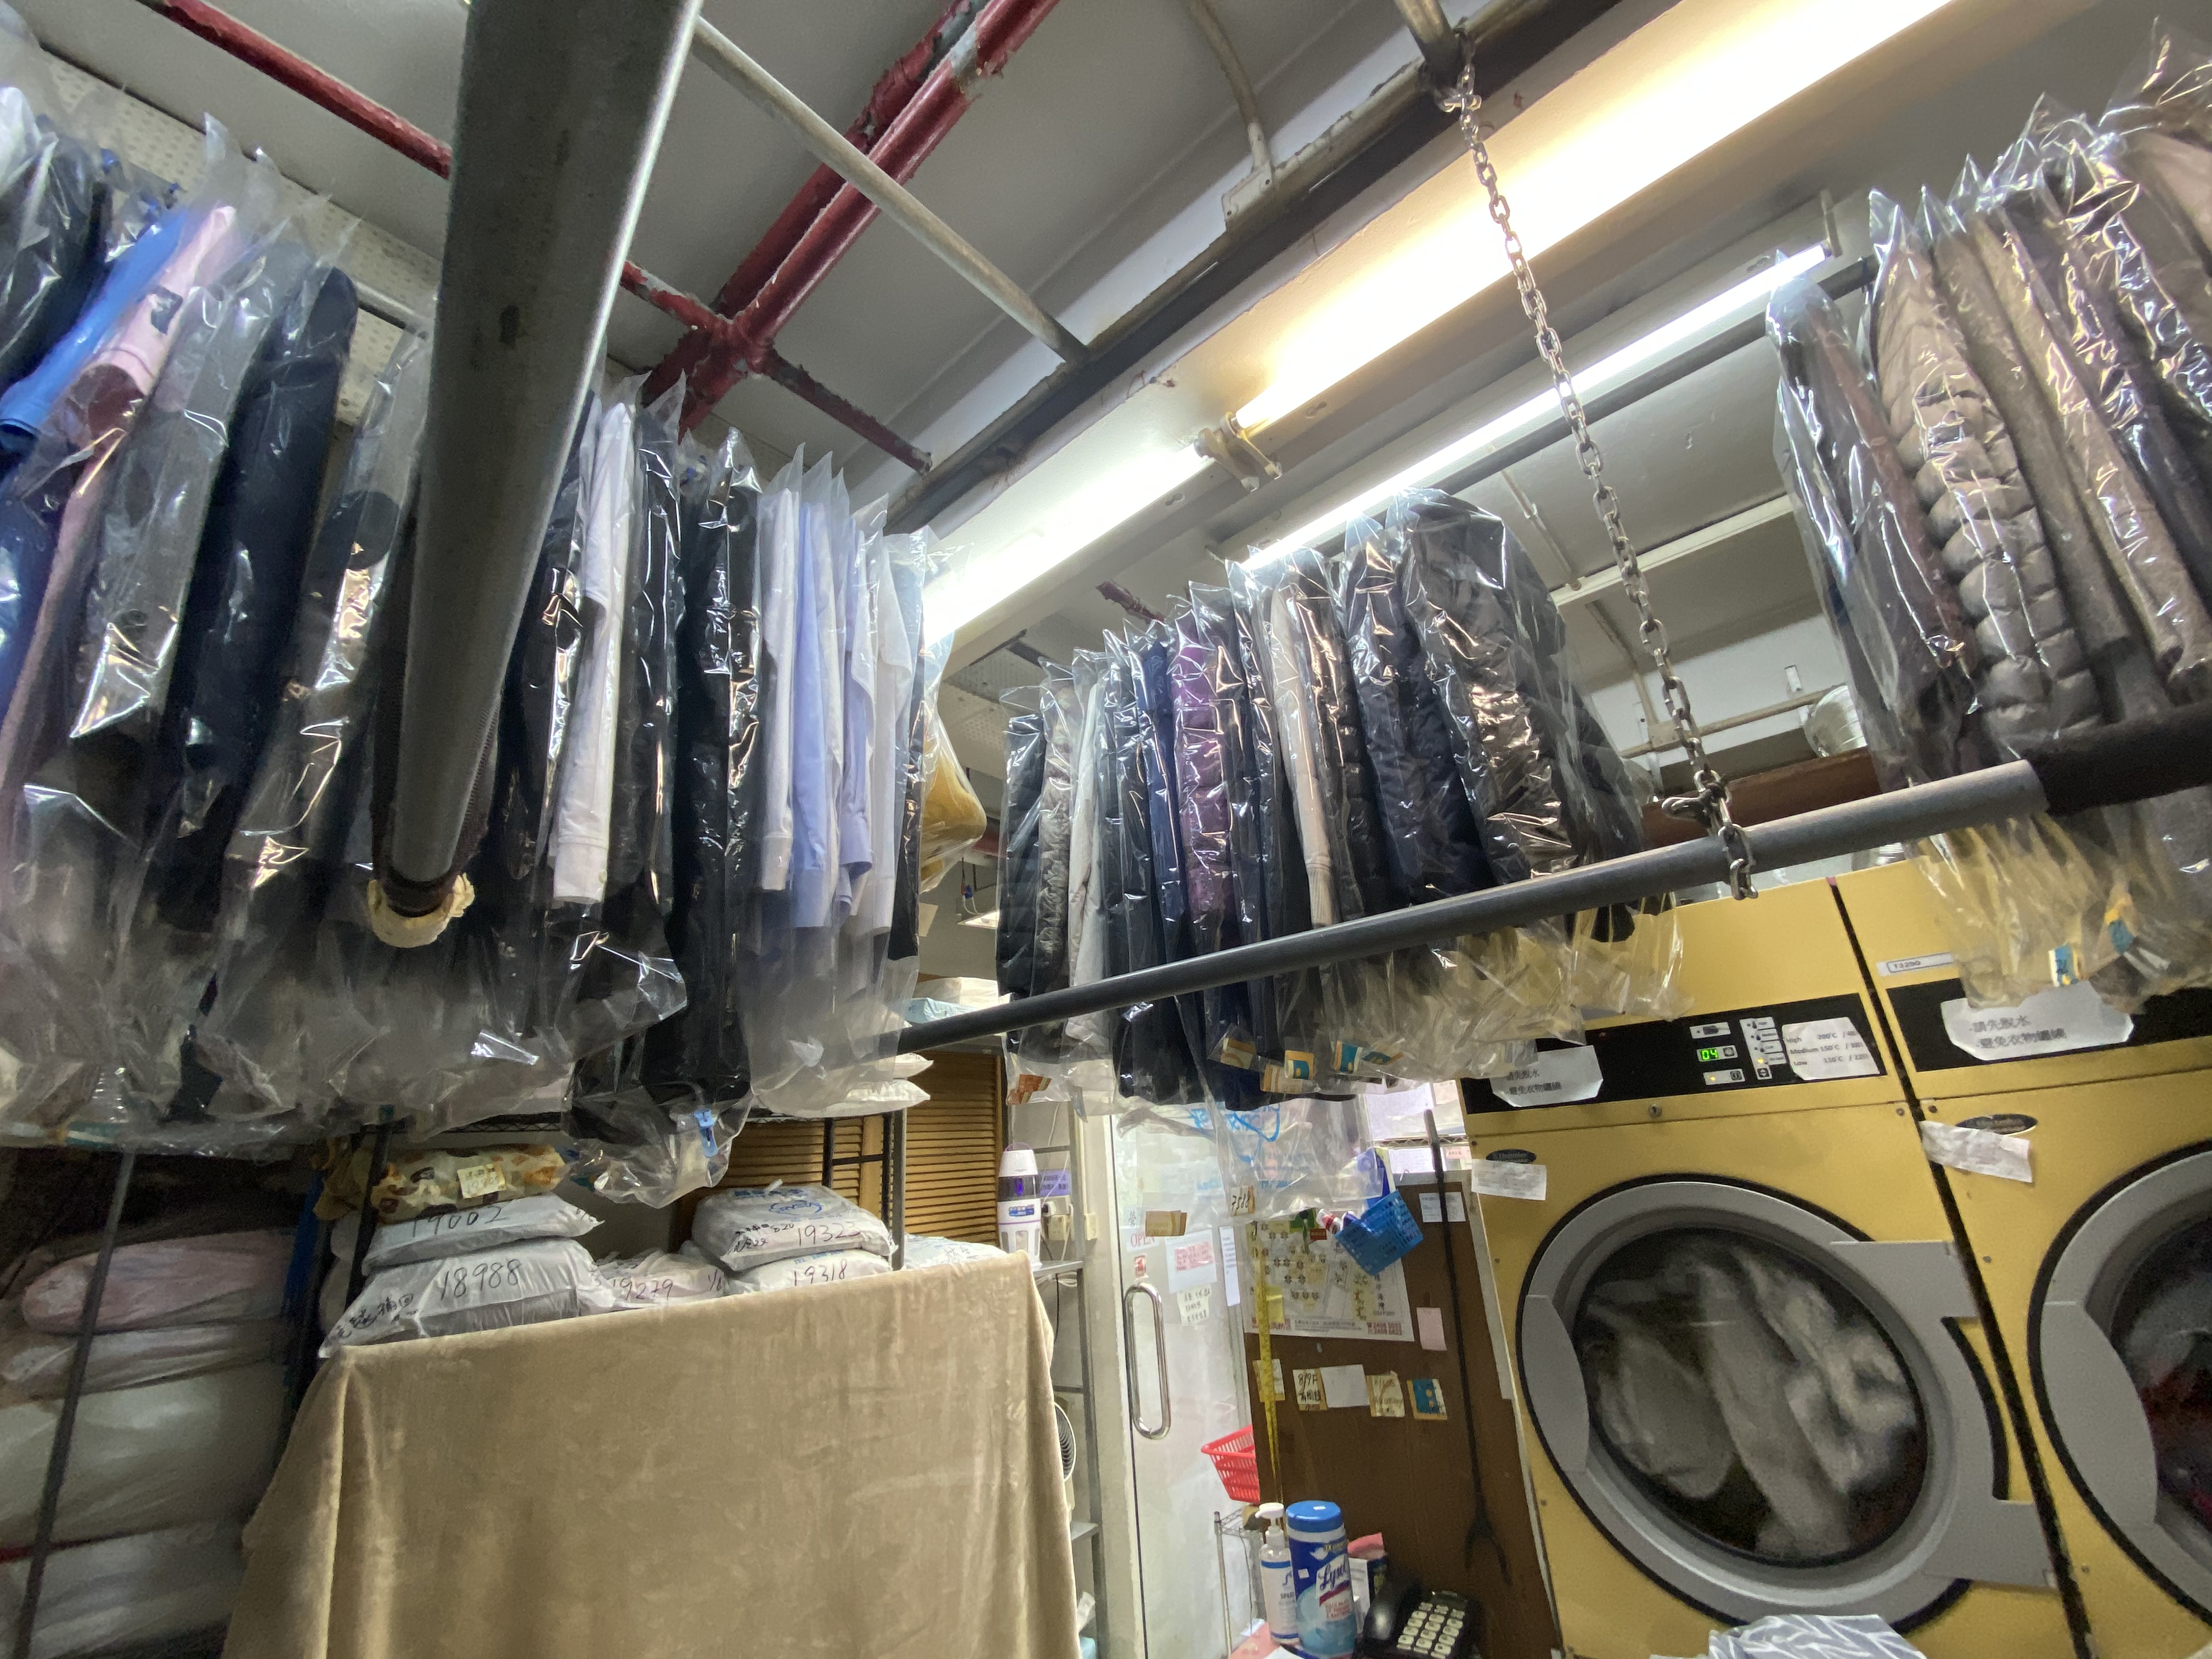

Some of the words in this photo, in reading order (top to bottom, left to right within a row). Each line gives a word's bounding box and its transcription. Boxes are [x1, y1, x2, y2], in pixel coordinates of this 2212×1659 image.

[1701, 1049, 1718, 1060] 04
[798, 1221, 861, 1246] 19323
[441, 1259, 522, 1301] 18988
[794, 1259, 847, 1286] 19318
[613, 1277, 674, 1300] 19279
